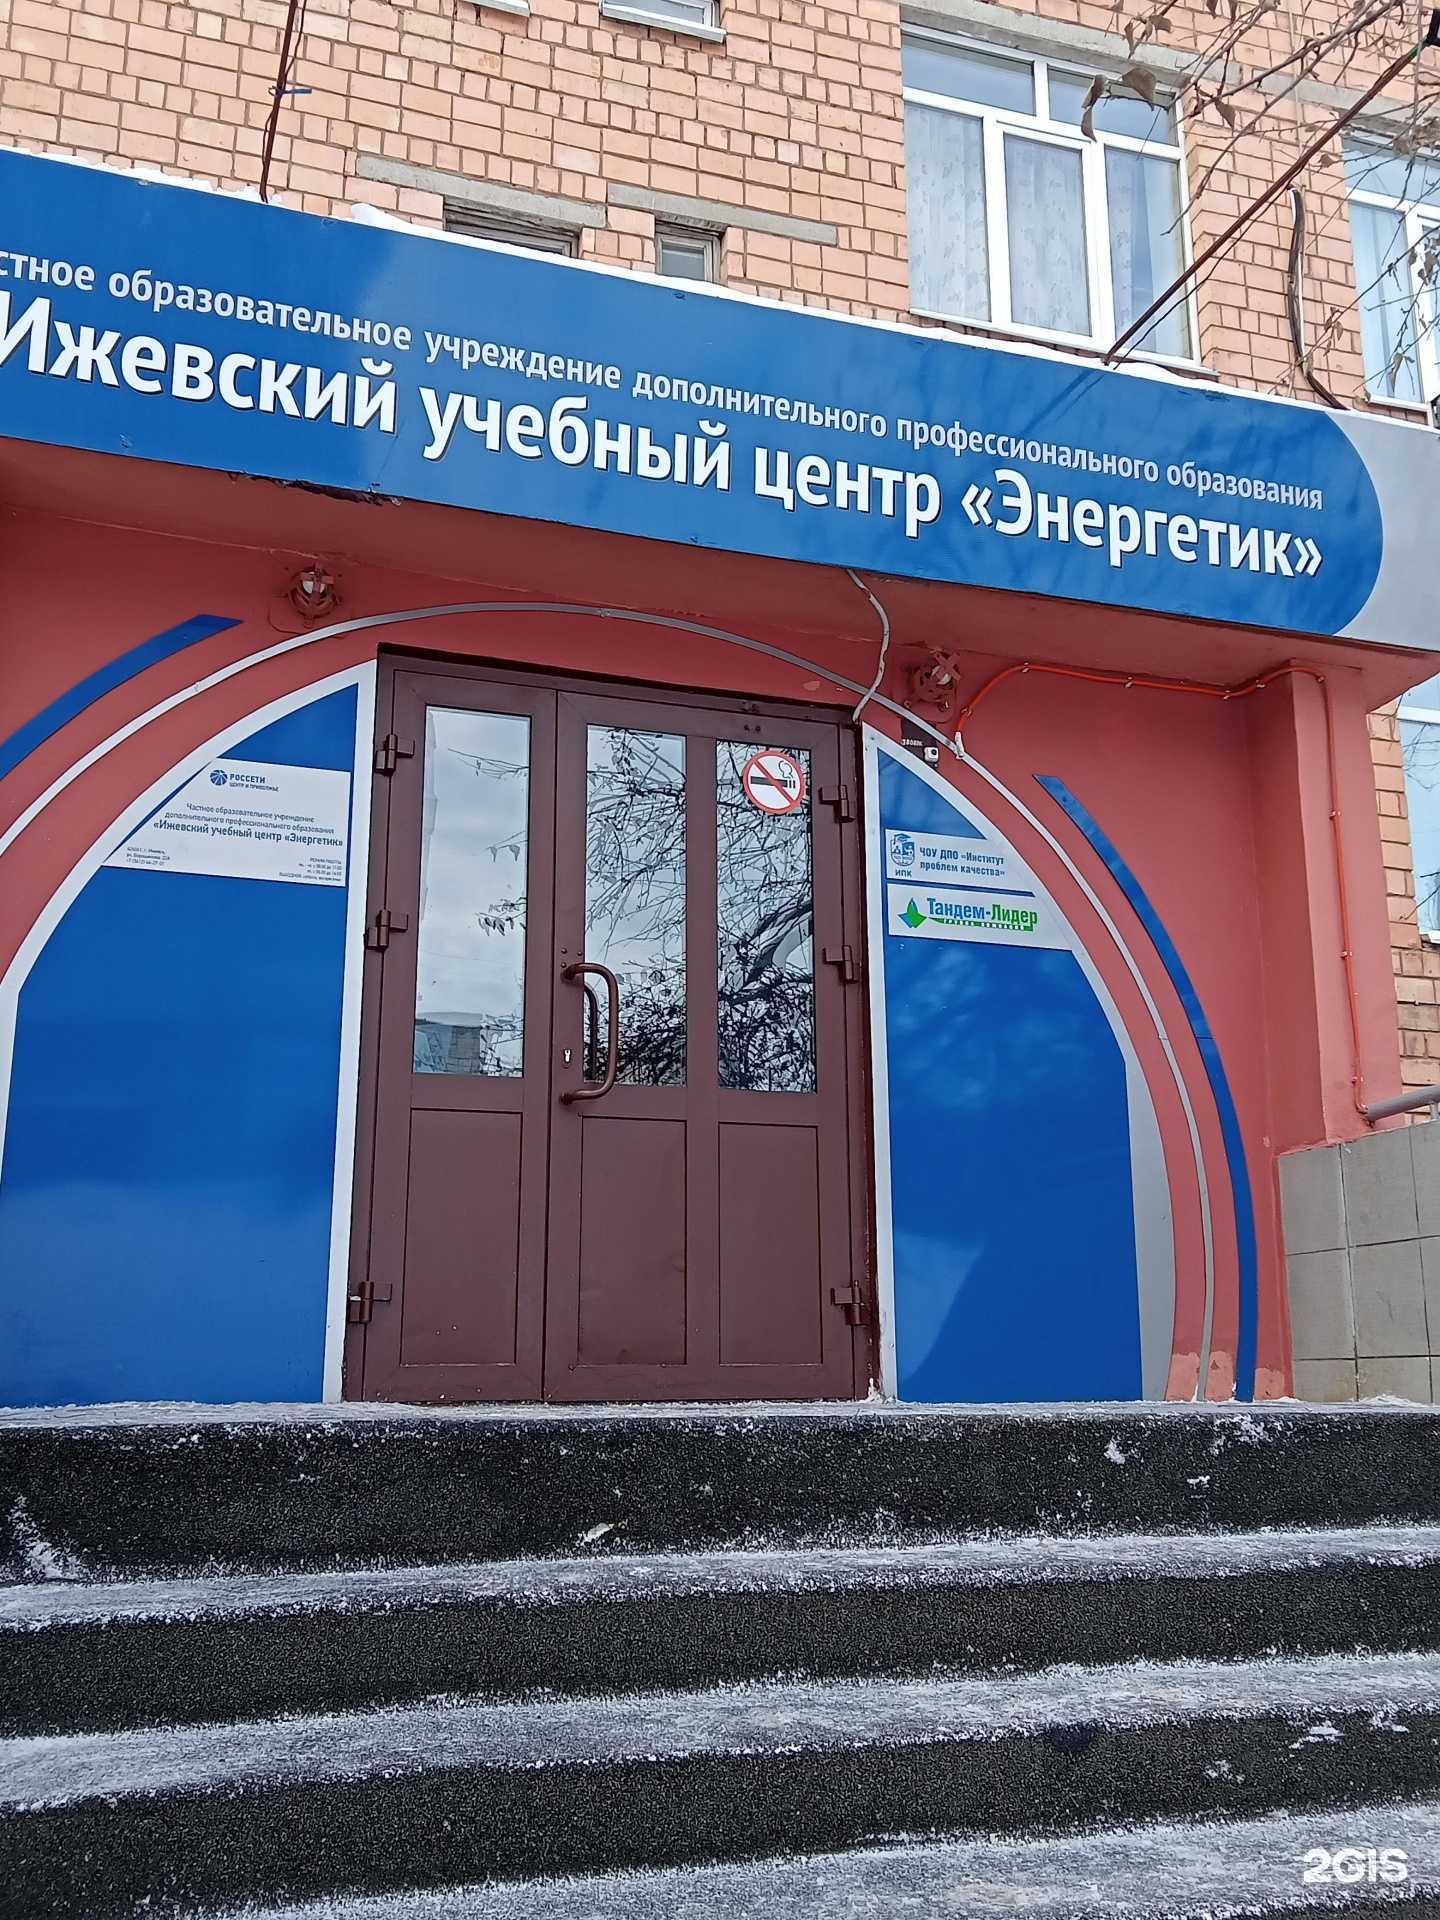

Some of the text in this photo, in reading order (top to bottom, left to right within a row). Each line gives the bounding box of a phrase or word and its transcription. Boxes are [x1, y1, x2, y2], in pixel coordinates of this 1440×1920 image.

[110, 269, 411, 350] образовательное
[425, 331, 621, 389] учреждение
[633, 372, 887, 437] дополнительного
[898, 419, 1159, 482] профессионального
[1167, 461, 1322, 510] образования
[0, 289, 1322, 577] Ижевский учебный центр «Энергетик»
[229, 773, 266, 784] РОССЕТИ
[164, 812, 335, 834] дополнительного профессионального образования
[186, 803, 315, 823] Частное образовательное учреждение
[153, 819, 343, 847] «Ижевский учебный центр «Энергетик»
[919, 847, 1004, 866] ЧОУ ДПО «Институт
[895, 869, 912, 878] ИПК
[920, 861, 1006, 877] проблем качества»
[927, 897, 1038, 926] Тандем-Лидер
